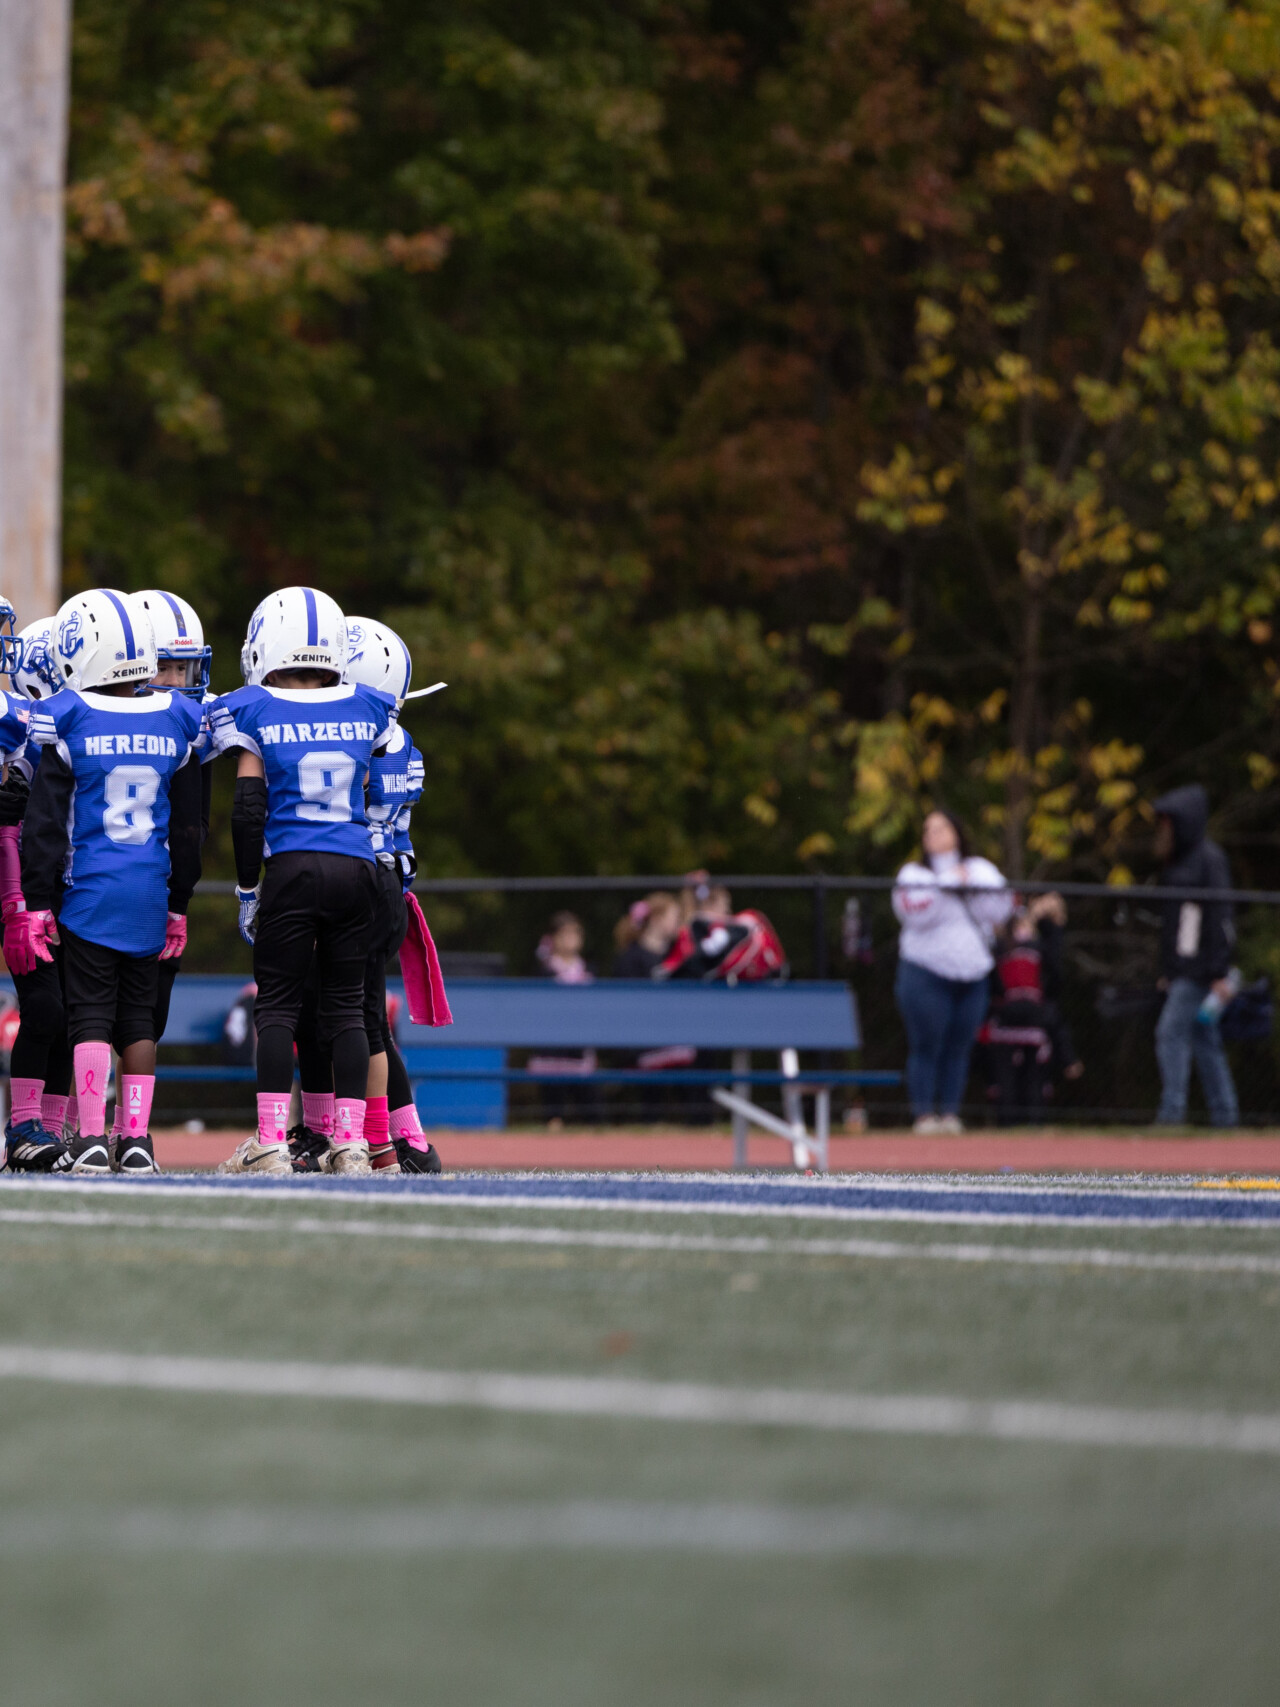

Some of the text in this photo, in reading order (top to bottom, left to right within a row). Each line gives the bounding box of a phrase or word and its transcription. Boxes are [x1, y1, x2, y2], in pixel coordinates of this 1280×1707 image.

[174, 638, 193, 646] Riddell
[291, 653, 332, 664] XENITH
[112, 665, 149, 679] XENITH
[84, 734, 177, 757] HEREDIA
[295, 750, 357, 822] 9
[102, 765, 162, 846] 8
